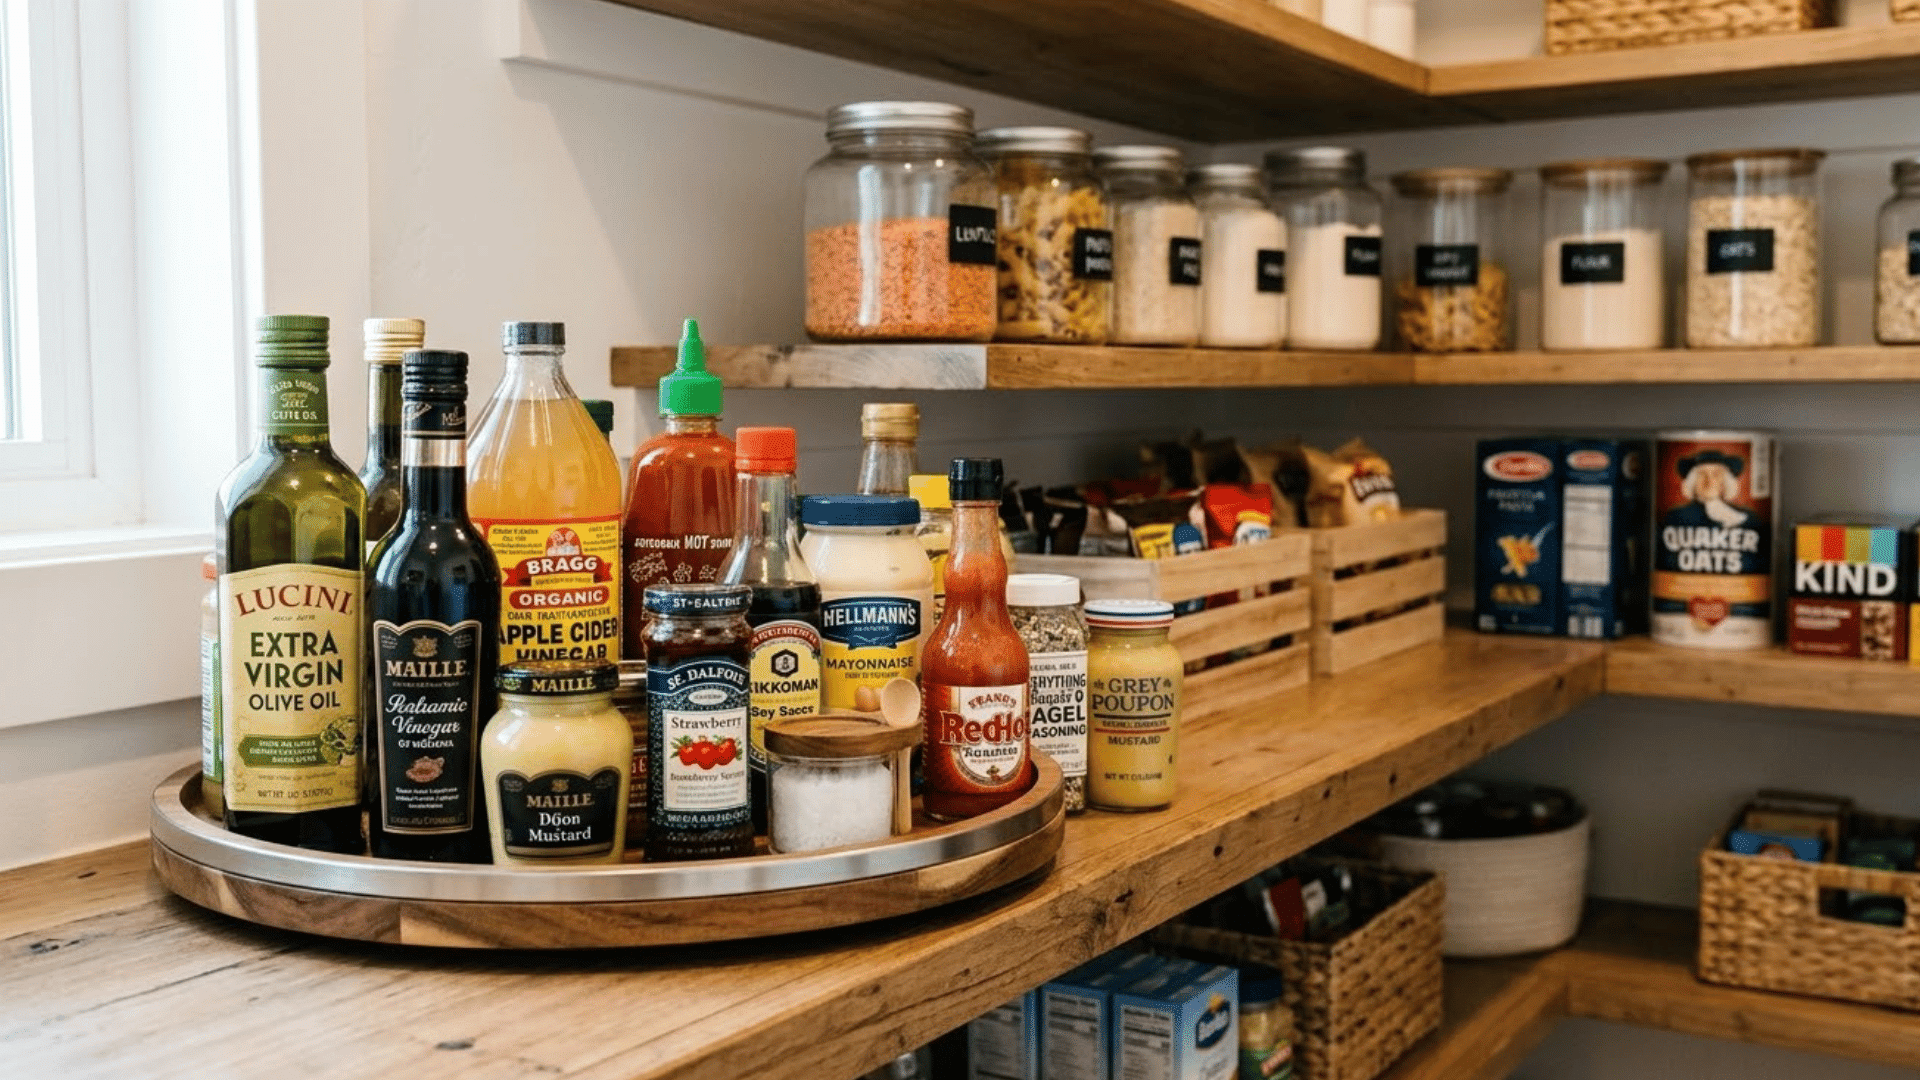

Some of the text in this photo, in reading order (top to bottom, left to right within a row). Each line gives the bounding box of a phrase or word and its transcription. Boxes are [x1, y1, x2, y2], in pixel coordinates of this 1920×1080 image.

[1662, 525, 1759, 551] QUAKER
[526, 556, 597, 575] BRAGG
[1678, 549, 1742, 573] OATS
[1795, 560, 1898, 596] KIND
[234, 584, 353, 617] LUCINI
[518, 589, 603, 606] ORGANIC
[823, 602, 916, 628] HELLMANN'S
[250, 630, 338, 658] EXTRA
[385, 660, 467, 678] MAILLE
[826, 656, 914, 670] MAYONNAISE
[244, 659, 344, 688] VIRGIN
[531, 677, 596, 692] MAILLE
[1108, 676, 1161, 693] GREY
[249, 690, 341, 711] OLIVE OIL
[1092, 692, 1174, 712] POUPON
[526, 793, 595, 808] MAILLE
[528, 827, 592, 842] Mustard
